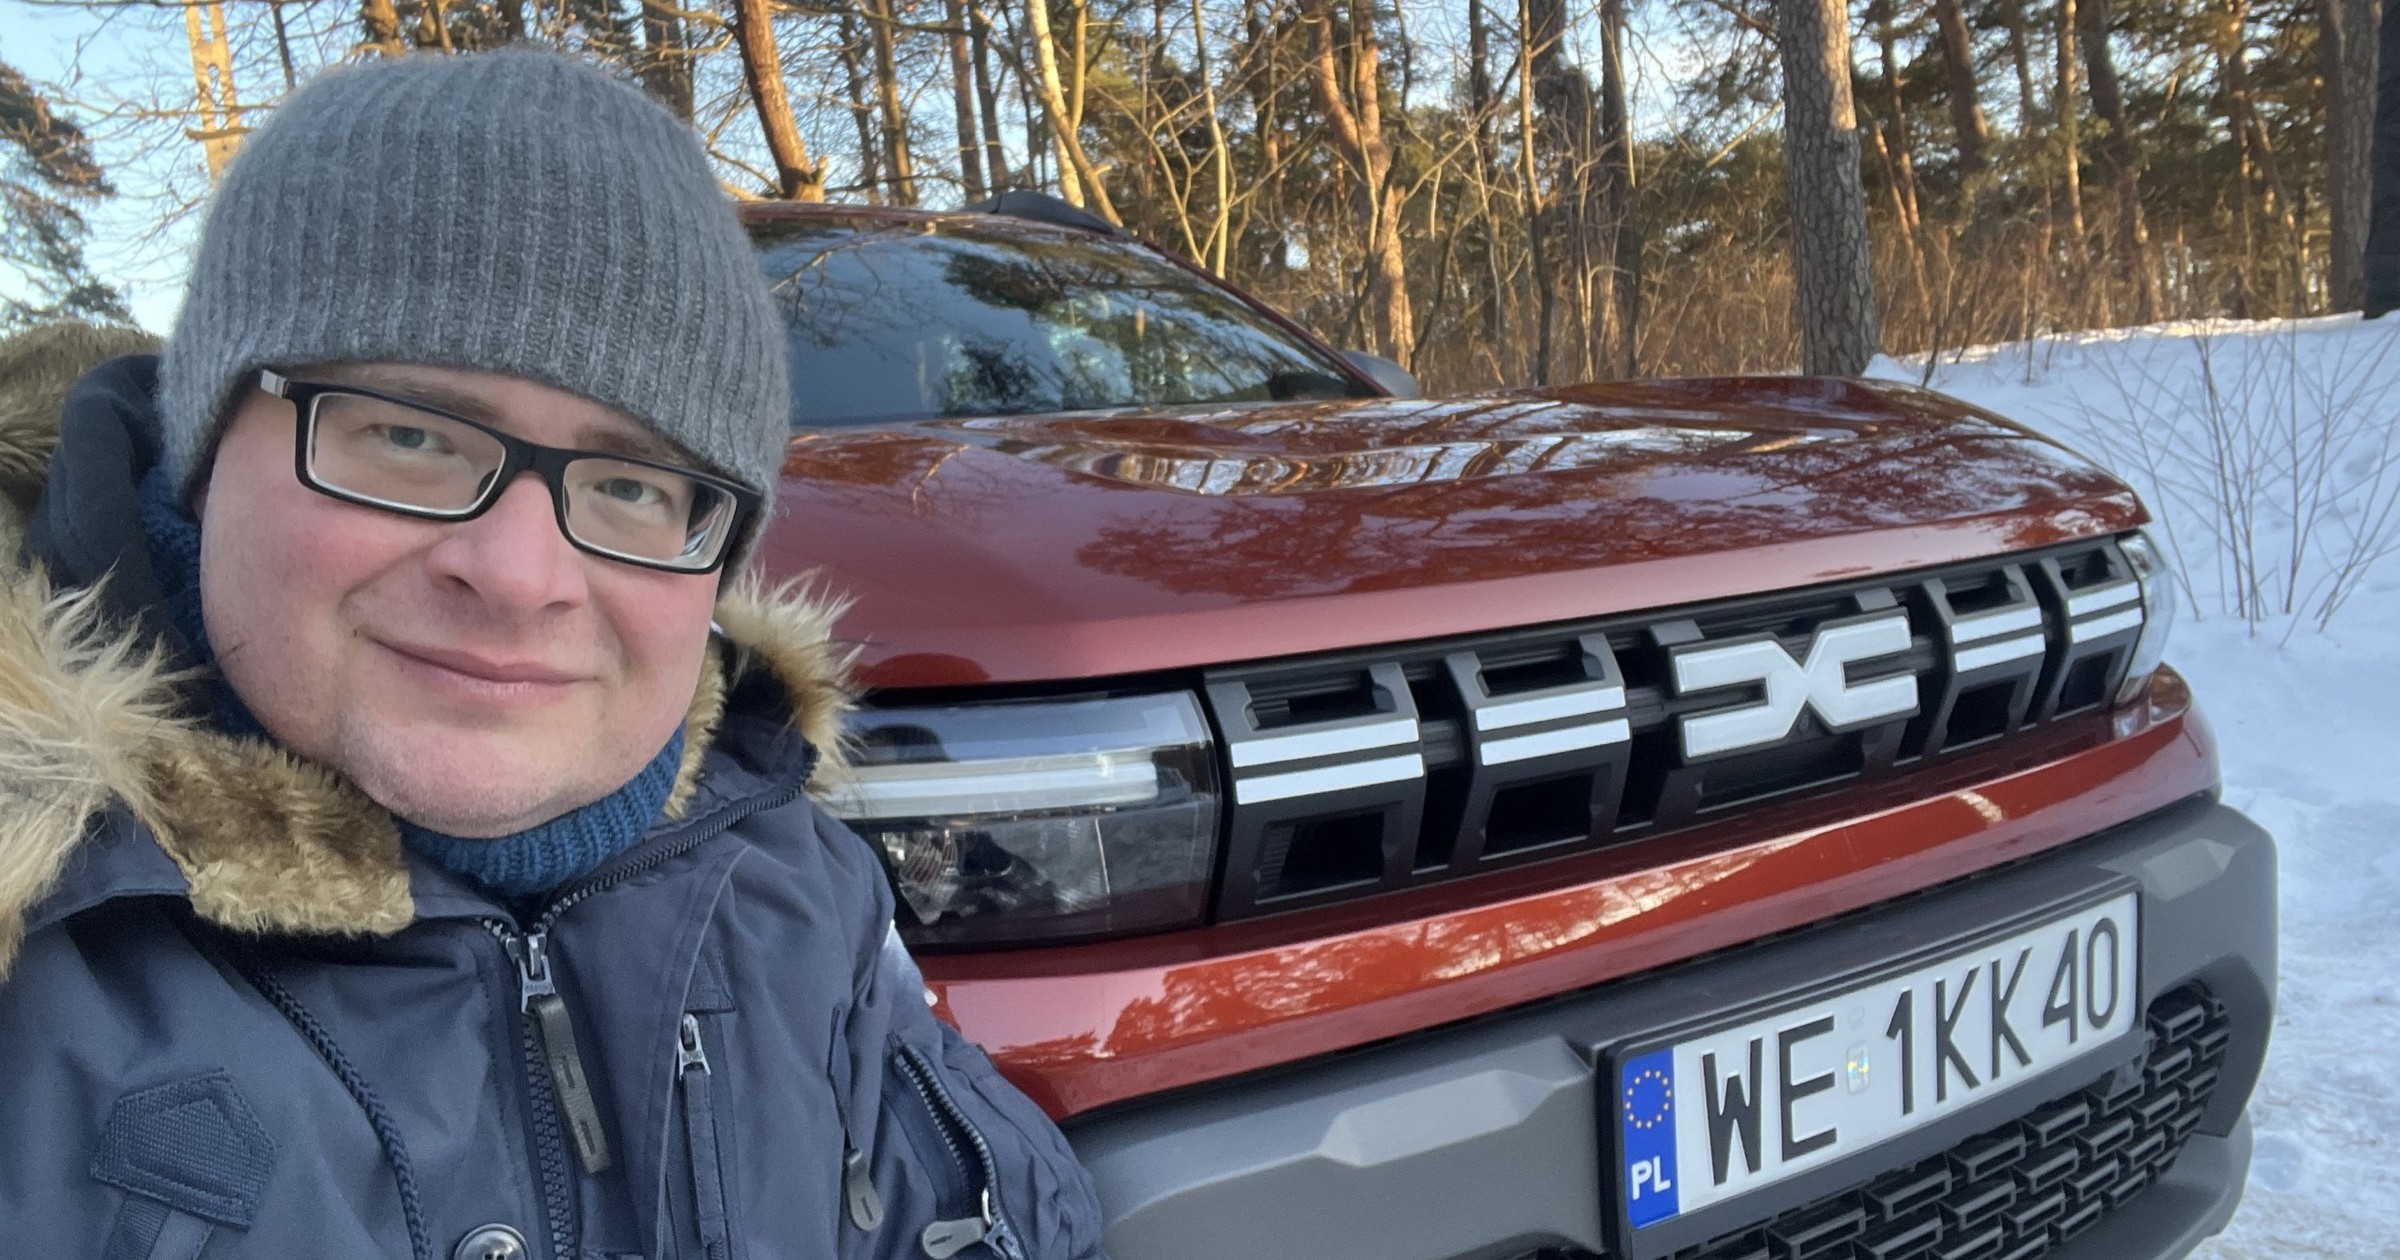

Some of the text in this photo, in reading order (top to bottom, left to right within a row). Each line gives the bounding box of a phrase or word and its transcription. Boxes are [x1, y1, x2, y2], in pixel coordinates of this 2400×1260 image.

[1702, 917, 2120, 1186] WE 1KK40
[1631, 1155, 1671, 1201] PL
